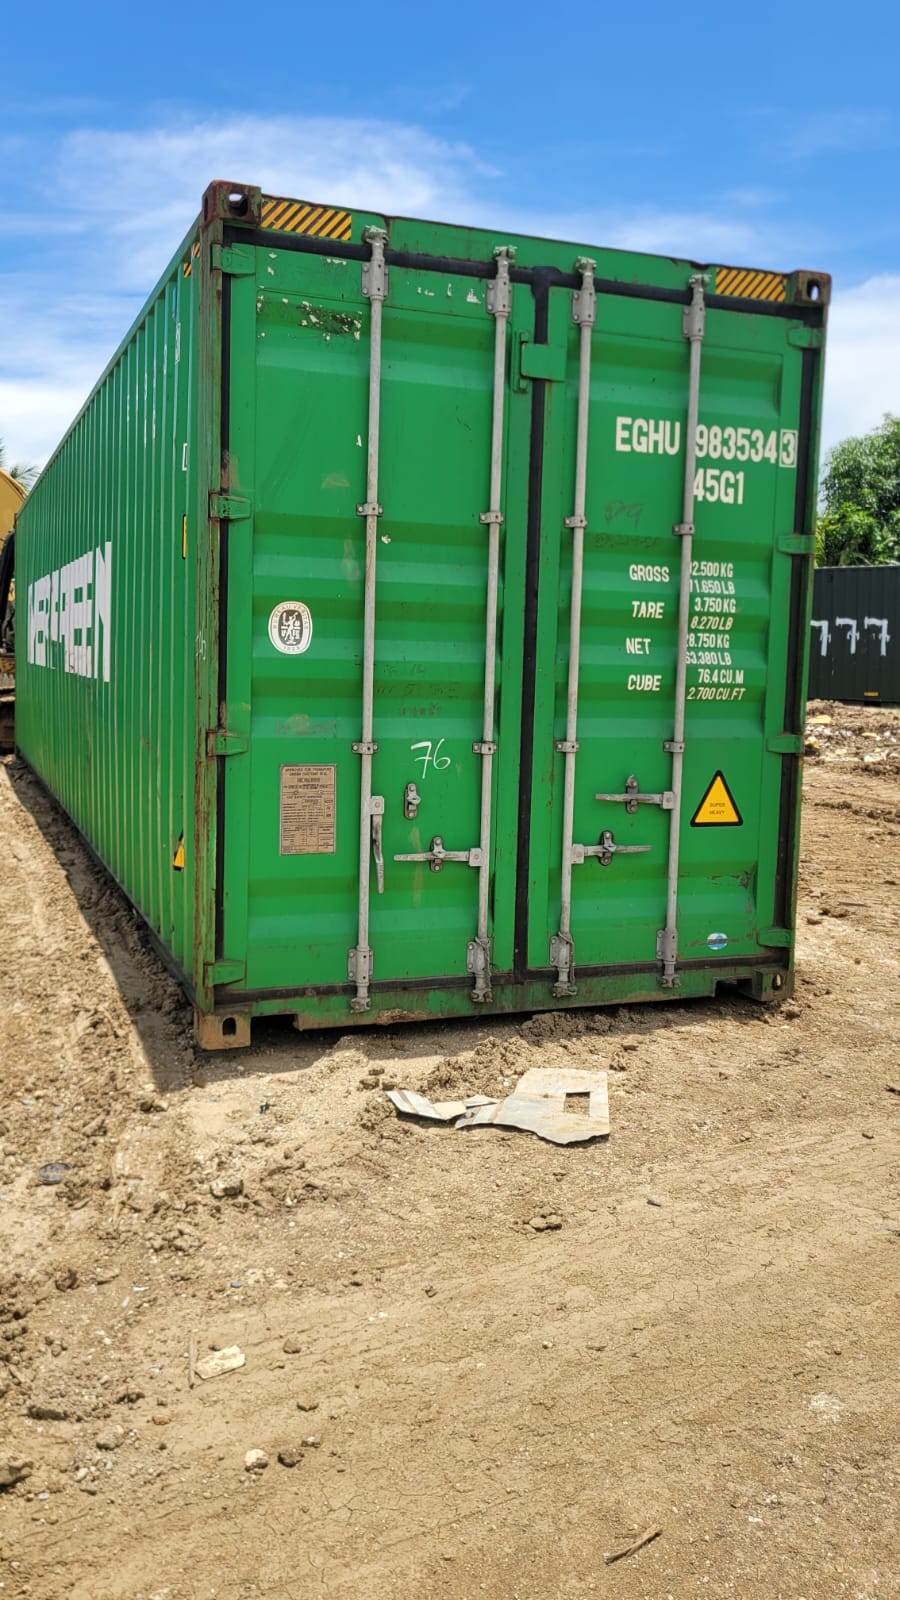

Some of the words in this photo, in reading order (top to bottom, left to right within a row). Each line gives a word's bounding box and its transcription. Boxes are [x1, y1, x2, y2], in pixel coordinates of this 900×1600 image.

[615, 416, 681, 455] EGHU
[695, 424, 778, 464] 983534
[693, 467, 744, 505] 45G1
[629, 564, 670, 582] GROSS
[720, 562, 734, 578] KG
[721, 581, 736, 595] LB
[632, 601, 665, 619] TARE
[694, 597, 721, 613] 3.750
[722, 598, 737, 613] KG
[690, 615, 719, 630] 8.270
[718, 617, 734, 631] LB
[626, 638, 651, 655] NET
[716, 633, 730, 648] KG
[718, 652, 732, 666] LB
[627, 674, 662, 692] CUBE
[698, 668, 719, 684] 76.4
[410, 738, 451, 779] 76
